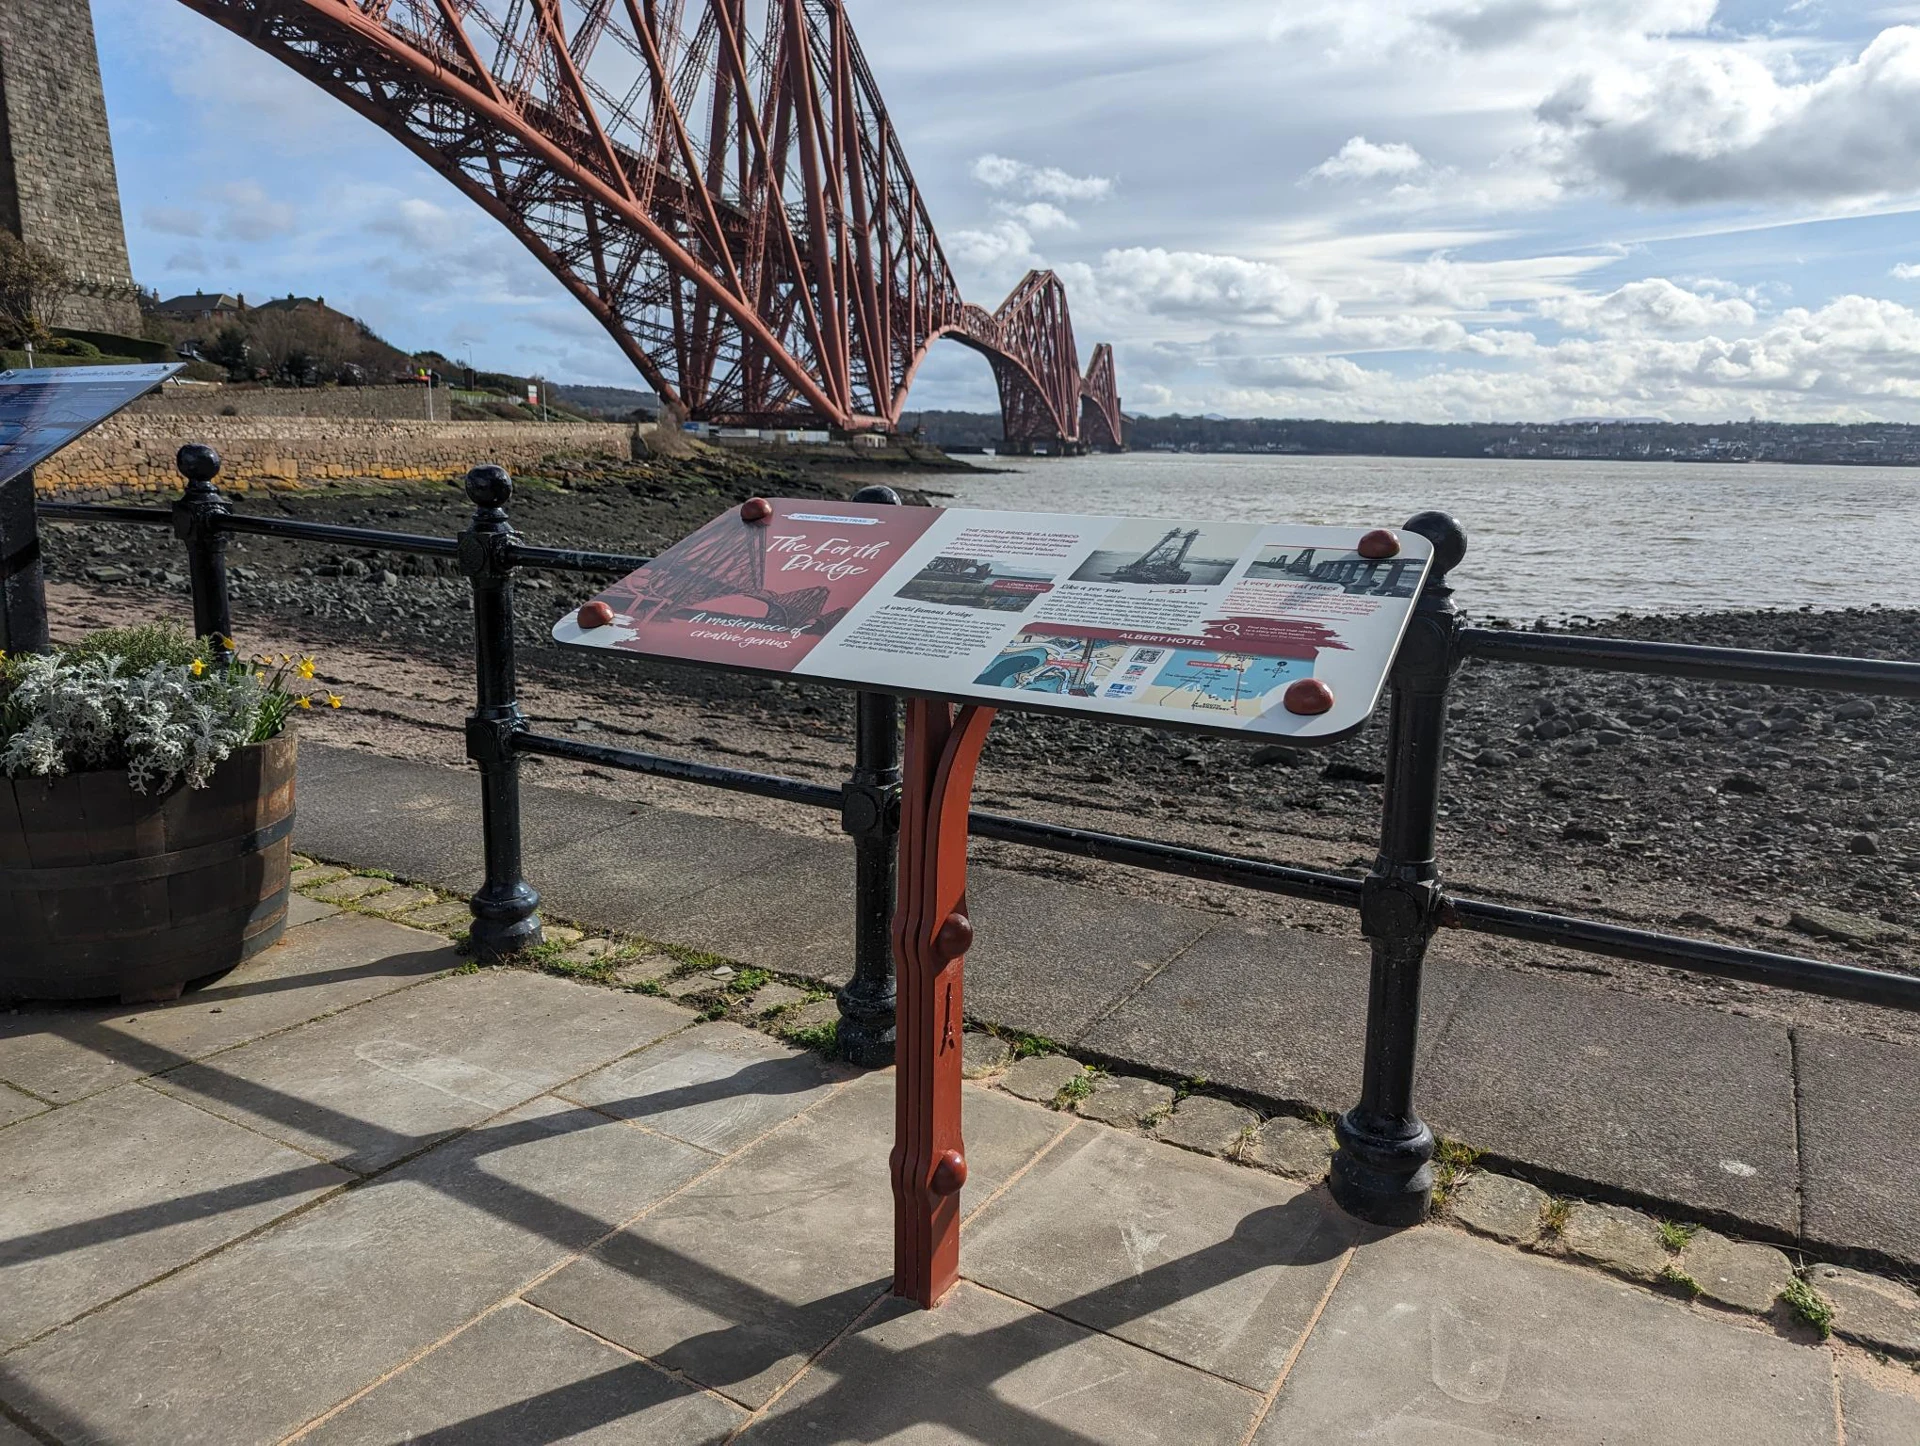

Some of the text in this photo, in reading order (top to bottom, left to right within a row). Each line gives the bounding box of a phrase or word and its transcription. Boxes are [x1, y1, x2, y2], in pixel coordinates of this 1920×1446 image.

[766, 535, 890, 559] The Forth
[781, 554, 869, 581] Bridge
[1309, 584, 1339, 592] place
[912, 607, 947, 615] famous
[943, 610, 975, 619] bridge
[688, 612, 812, 640] A masterpiece of
[690, 630, 791, 649] creative genius
[1118, 632, 1206, 646] ALBERT HOTEL
